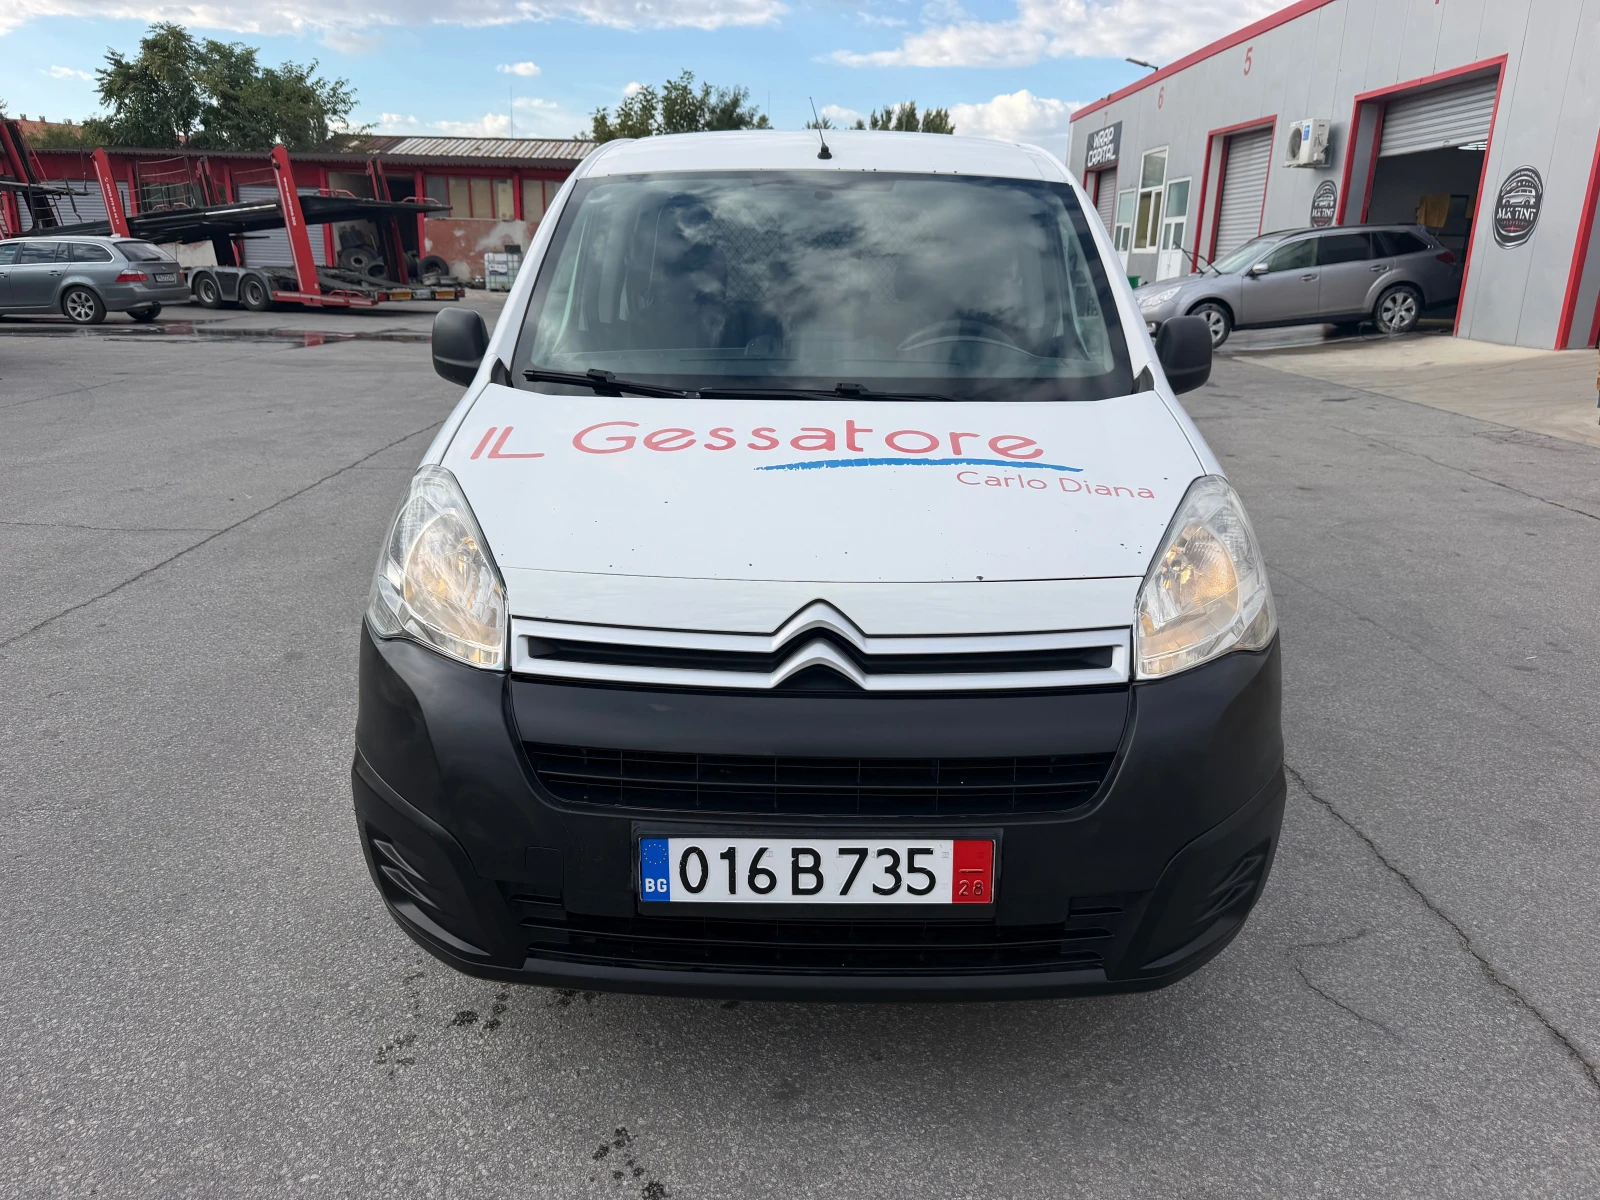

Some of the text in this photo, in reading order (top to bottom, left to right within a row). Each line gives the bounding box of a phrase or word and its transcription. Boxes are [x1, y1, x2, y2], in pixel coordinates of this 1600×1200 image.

[1243, 46, 1254, 76] 5
[1157, 86, 1165, 110] 6
[1093, 126, 1115, 149] WRAP
[1087, 142, 1117, 168] CAPITAL
[1515, 207, 1537, 221] TINT
[469, 419, 1044, 460] IL Gessatore
[956, 471, 1155, 499] Carlo Diana
[645, 878, 668, 893] BG
[958, 880, 984, 897] 28
